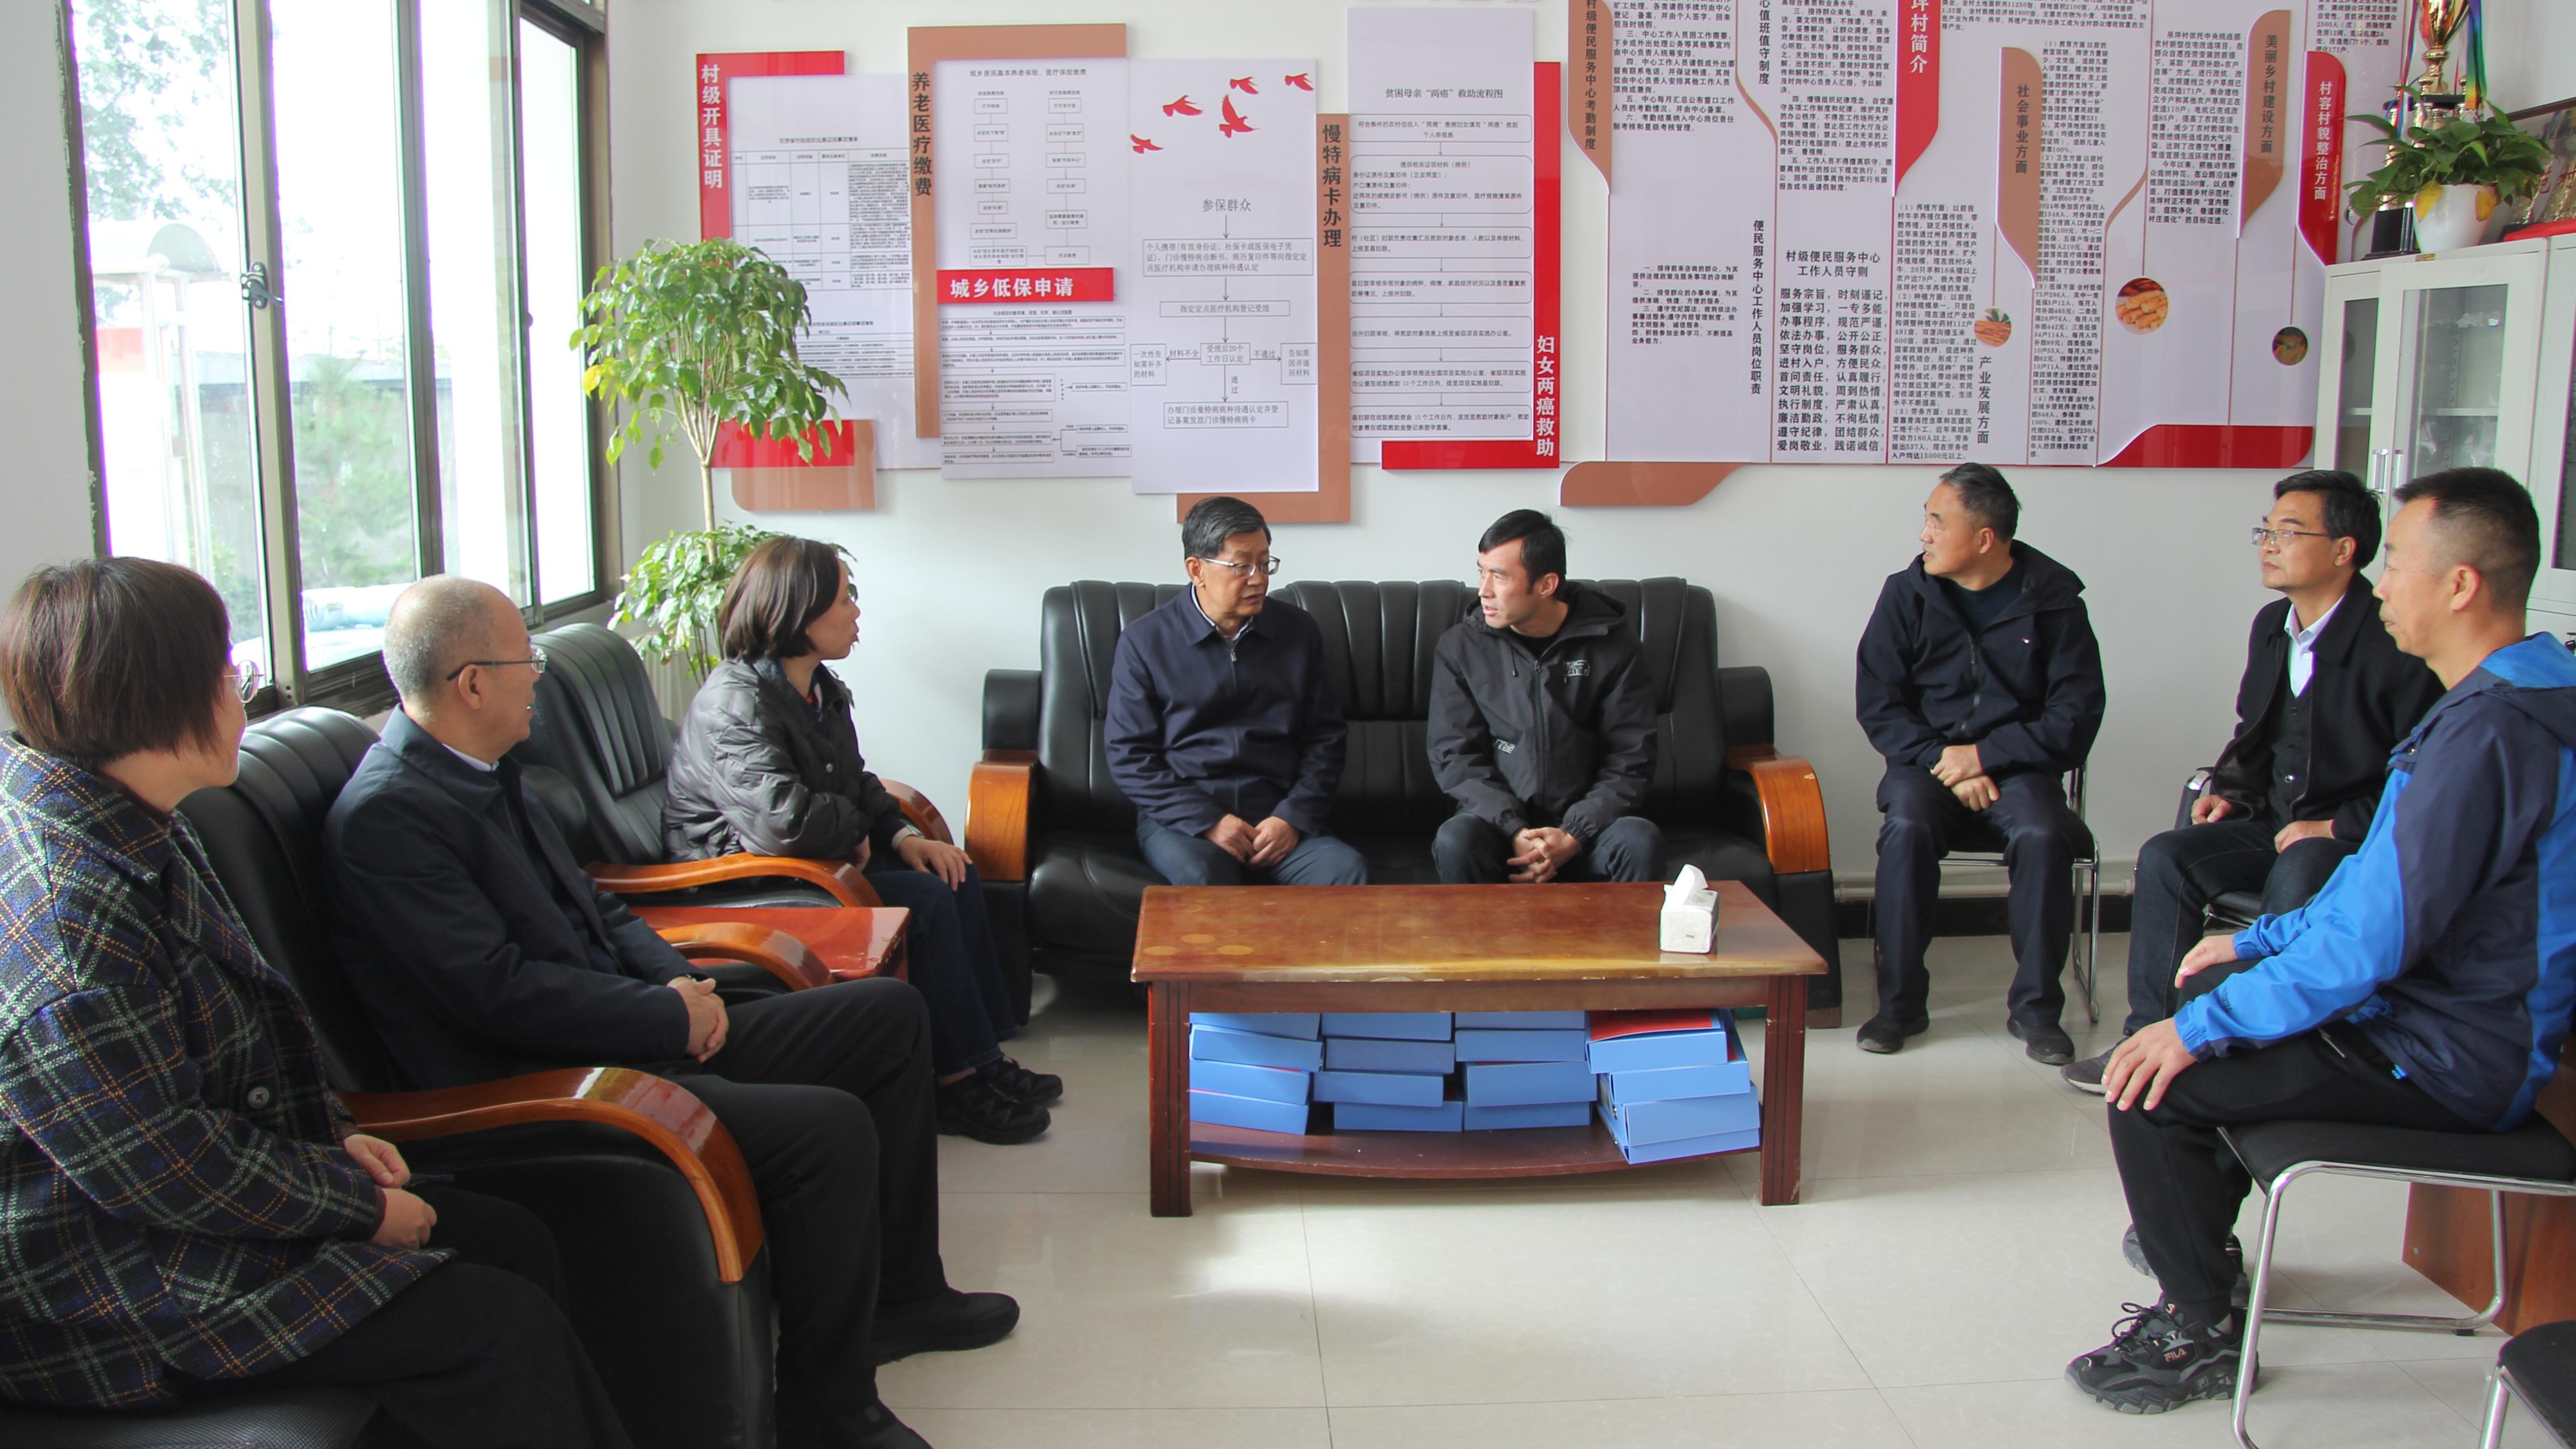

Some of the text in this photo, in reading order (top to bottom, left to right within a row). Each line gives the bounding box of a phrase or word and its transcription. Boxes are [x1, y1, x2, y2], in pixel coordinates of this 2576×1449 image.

[1585, 0, 1597, 150] 村级便民服务中心考勤制度
[2261, 35, 2277, 154] 美丽乡村建设方面
[701, 64, 723, 189] 村级开具证明
[2016, 85, 2030, 174] 社会事业方面
[912, 72, 932, 196] 养老医疗缴费
[2314, 82, 2332, 200] 村容村貌整治方面
[1322, 124, 1342, 247] 慢特病卡办理
[1202, 199, 1251, 212] 参保群众
[1786, 251, 1880, 263] 村级便民服务中心
[1798, 265, 1869, 277] 工作人员守则
[950, 277, 1074, 298] 城乡低保申请
[1780, 288, 1891, 300] 服务宗旨，时刻谨记，
[1180, 304, 1270, 313] 指定定点医疗机构登记受理
[1750, 220, 1764, 394] 便民服务中心工作人员岗位职责
[1780, 301, 1890, 314] 加强学习，一专多能。
[1780, 315, 1890, 328] 办事程序，规范严谨，
[1780, 329, 1889, 342] 依法办事，公开公正。
[1134, 350, 1162, 359] 一次性告
[1169, 349, 1199, 358] 材料不全
[1207, 344, 1244, 353] 受理后20个
[1254, 350, 1275, 358] 不通过
[1289, 349, 1309, 357] 告知原
[1780, 343, 1886, 356] 坚守岗位，服务群众，
[1207, 355, 1244, 363] 工作日认定
[1779, 357, 1886, 369] 进村入户，方便民众。
[1134, 370, 1156, 378] 的材料
[1780, 370, 1885, 383] 首问责任，认真履行，
[1536, 335, 1555, 456] 妇女两癌救助
[1779, 384, 1885, 396] 文明礼貌，周到热情。
[1778, 398, 1884, 411] 执行制度，严肃认真，
[1977, 356, 1991, 444] 产业发展方面
[1778, 412, 1884, 424] 廉洁勤政，不徇私情。
[1778, 426, 1884, 438] 遵守纪律，团结群众，
[1777, 439, 1884, 451] 爱岗敬业，践诺诚信。
[2164, 1348, 2187, 1361] FILA
